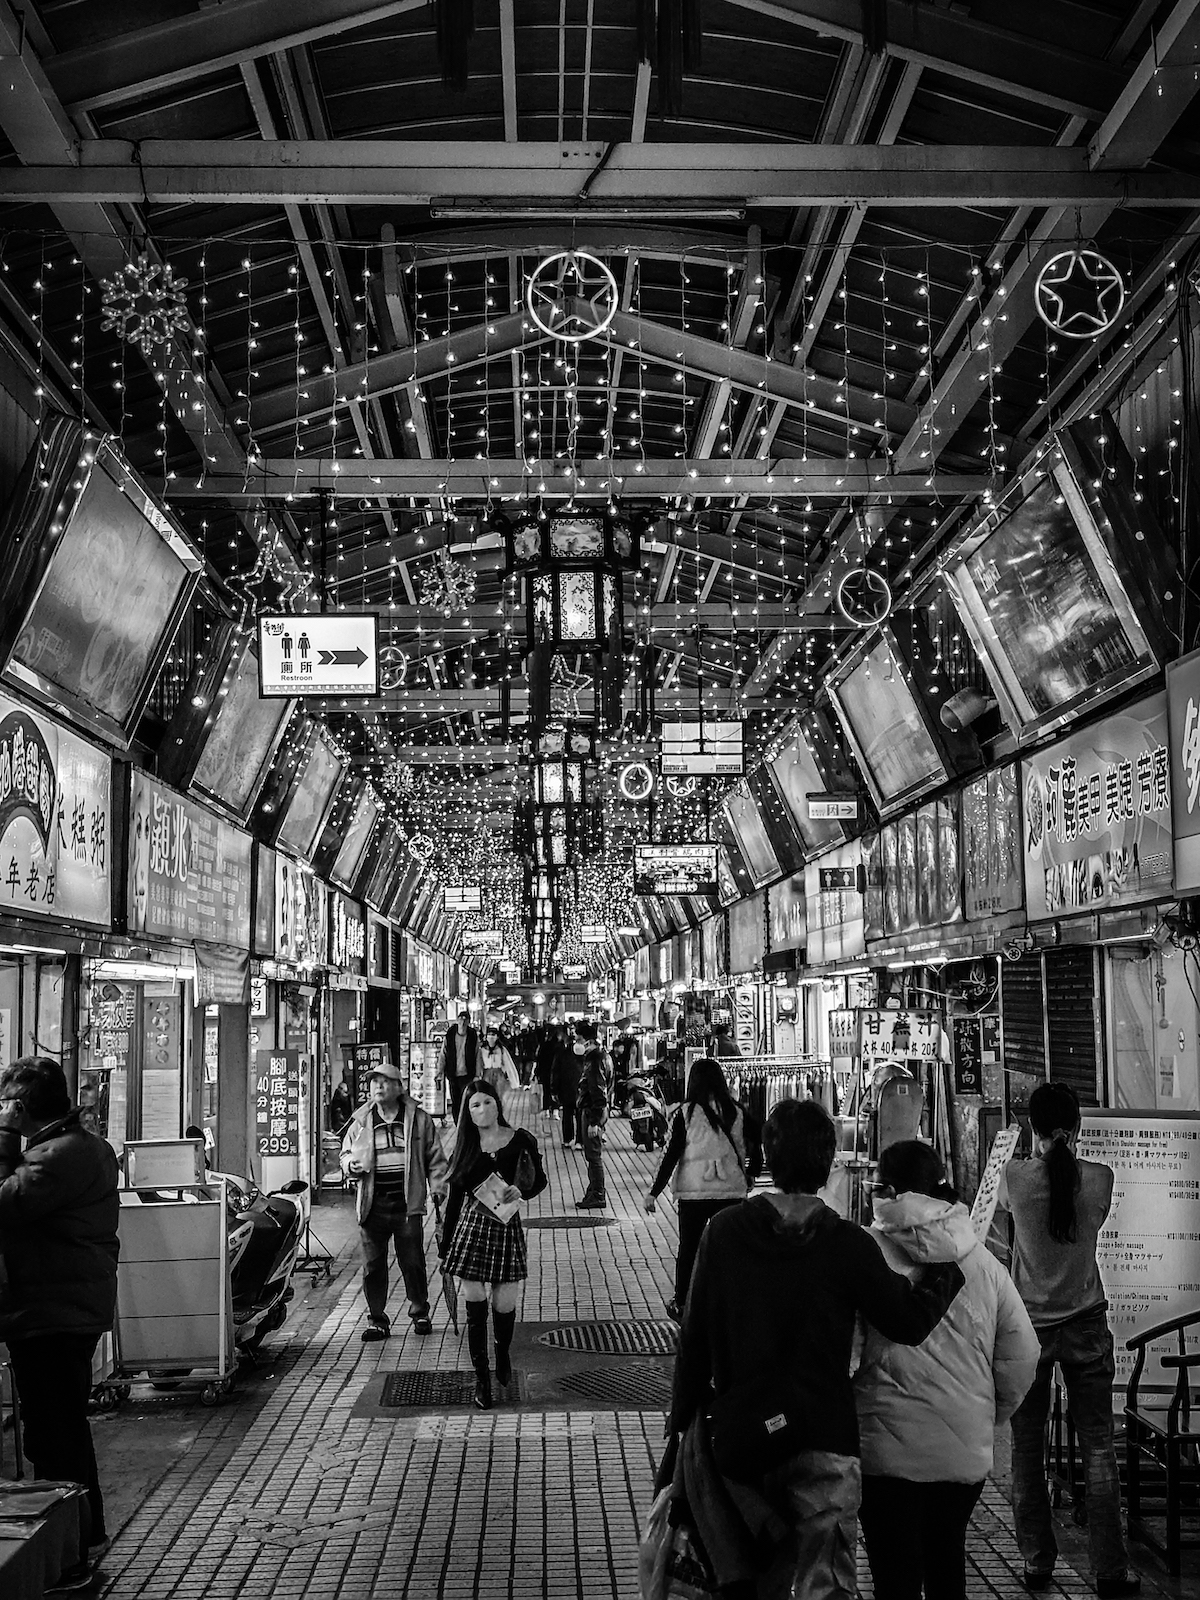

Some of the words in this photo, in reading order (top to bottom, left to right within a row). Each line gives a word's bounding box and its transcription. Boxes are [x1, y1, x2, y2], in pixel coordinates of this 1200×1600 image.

[281, 661, 313, 674] 廁所
[0, 855, 56, 905] 年老店
[864, 1010, 938, 1037] 甘蔗汁
[959, 1021, 976, 1085] 疏散方向
[270, 1057, 287, 1137] 腳底按摩
